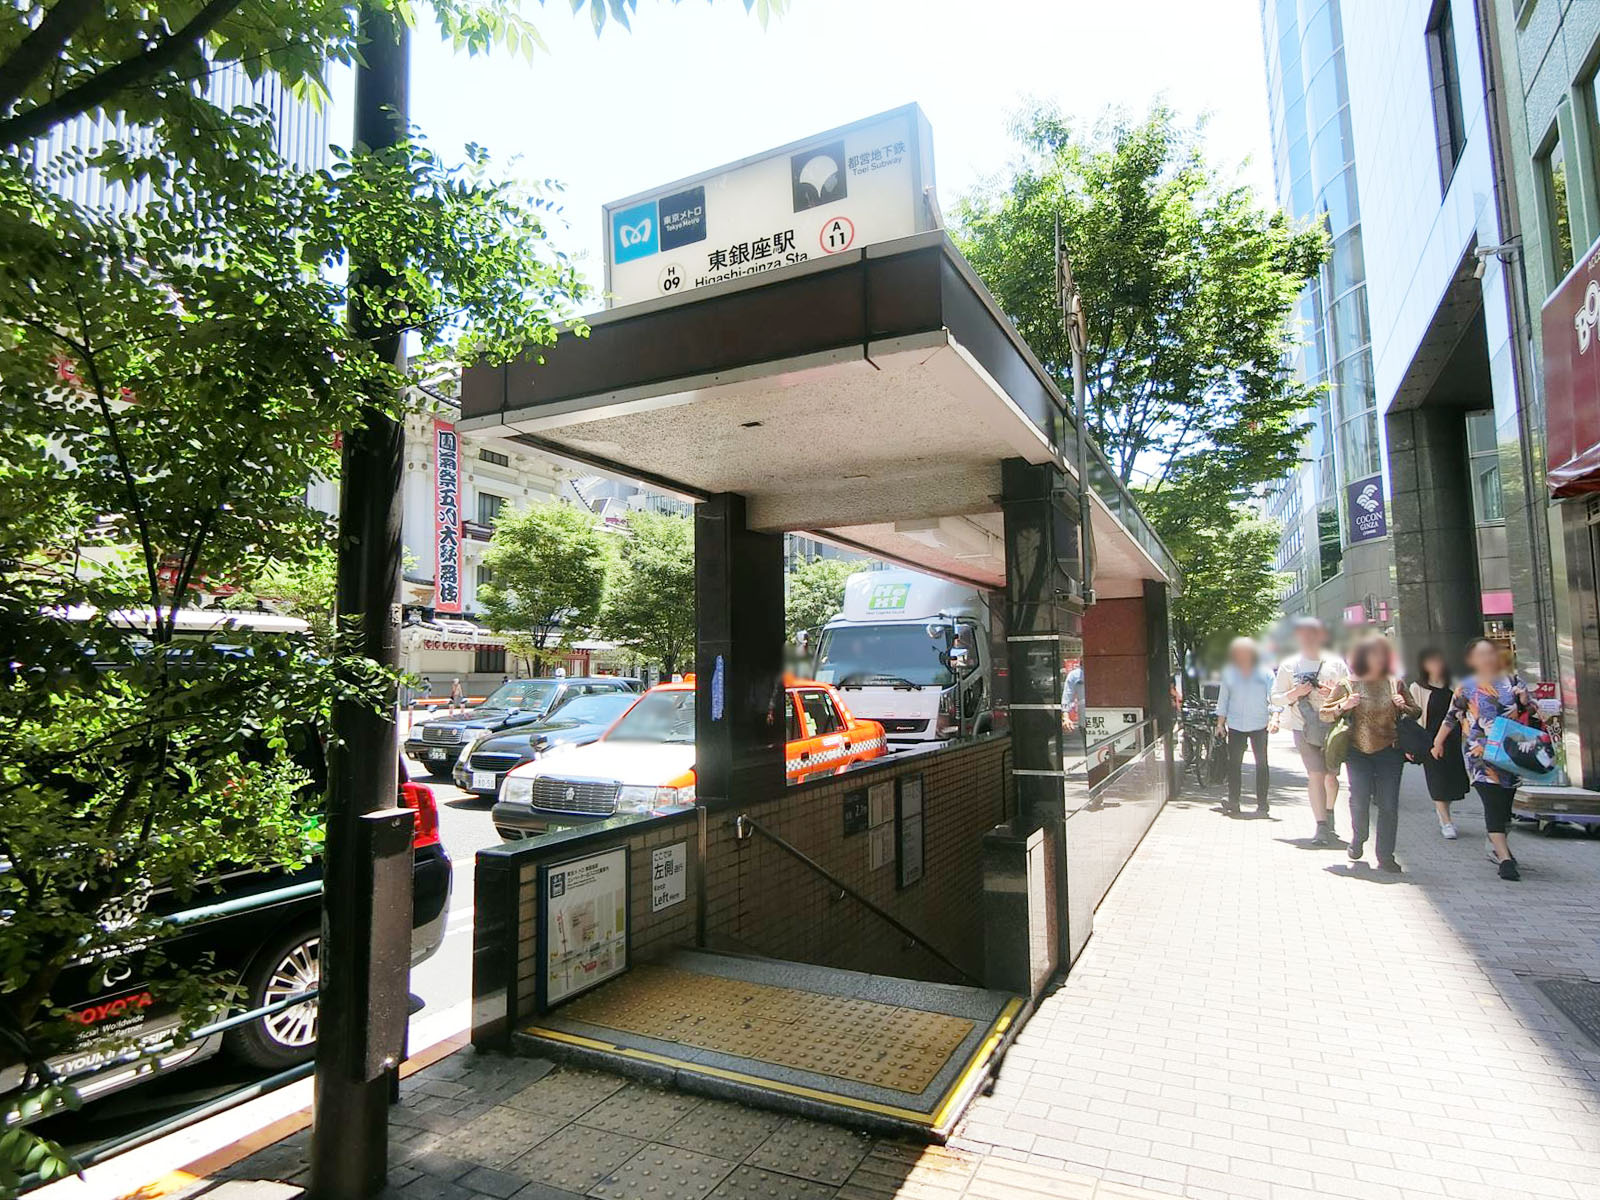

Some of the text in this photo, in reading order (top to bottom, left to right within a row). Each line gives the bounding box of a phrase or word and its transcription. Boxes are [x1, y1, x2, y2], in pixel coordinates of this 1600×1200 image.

[848, 140, 906, 170] 都営地下鉄
[852, 156, 903, 176] Toei Subway
[663, 206, 702, 225] 東京メトロ
[666, 217, 700, 232] Tokyo Metro
[832, 221, 841, 232] A
[829, 232, 845, 247] 11
[707, 229, 796, 272] 東銀座駅
[668, 267, 675, 276] H
[663, 277, 680, 291] 09
[1575, 280, 1600, 355] BO
[1356, 511, 1383, 525] COCON
[1360, 521, 1379, 531] GINZA
[654, 891, 669, 906] Left
